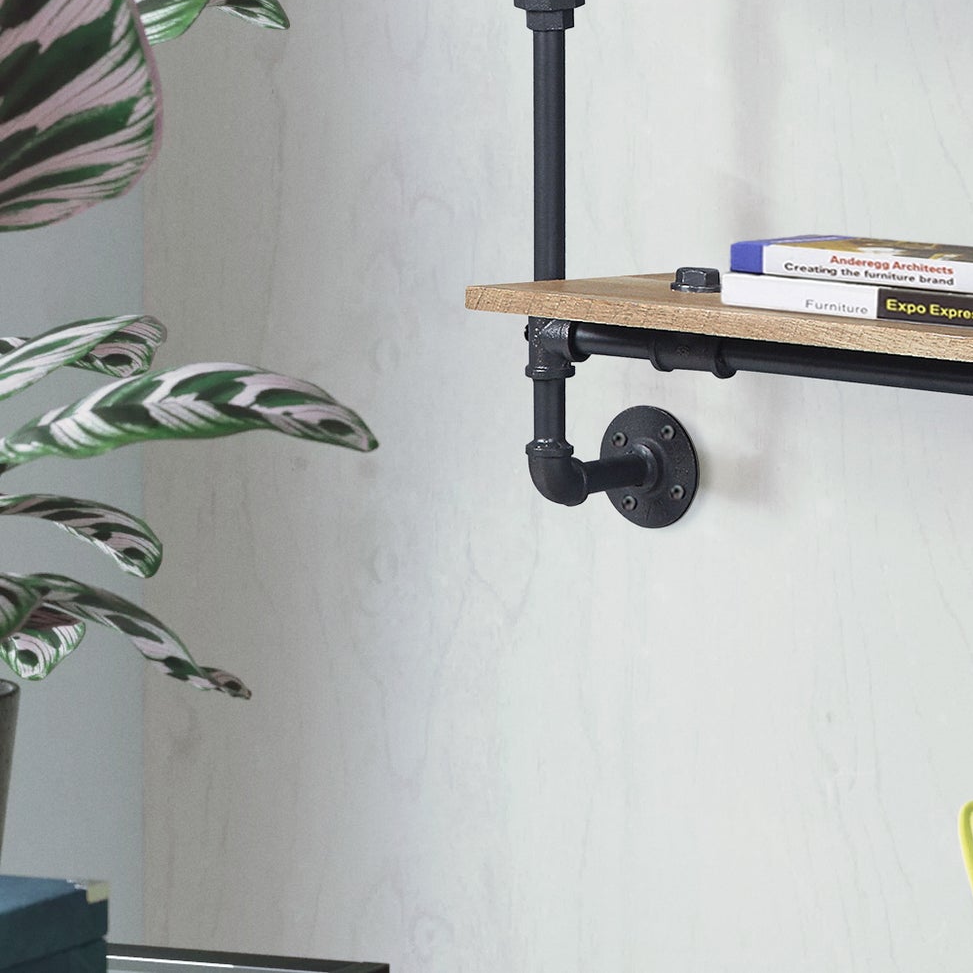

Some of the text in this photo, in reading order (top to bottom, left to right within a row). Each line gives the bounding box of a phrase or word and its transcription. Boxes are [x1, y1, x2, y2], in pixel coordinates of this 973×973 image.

[784, 262, 955, 286] Creating the furniture brand
[830, 254, 954, 275] Anderegg Architects
[805, 298, 869, 315] Furniture
[886, 298, 927, 315] Expo
